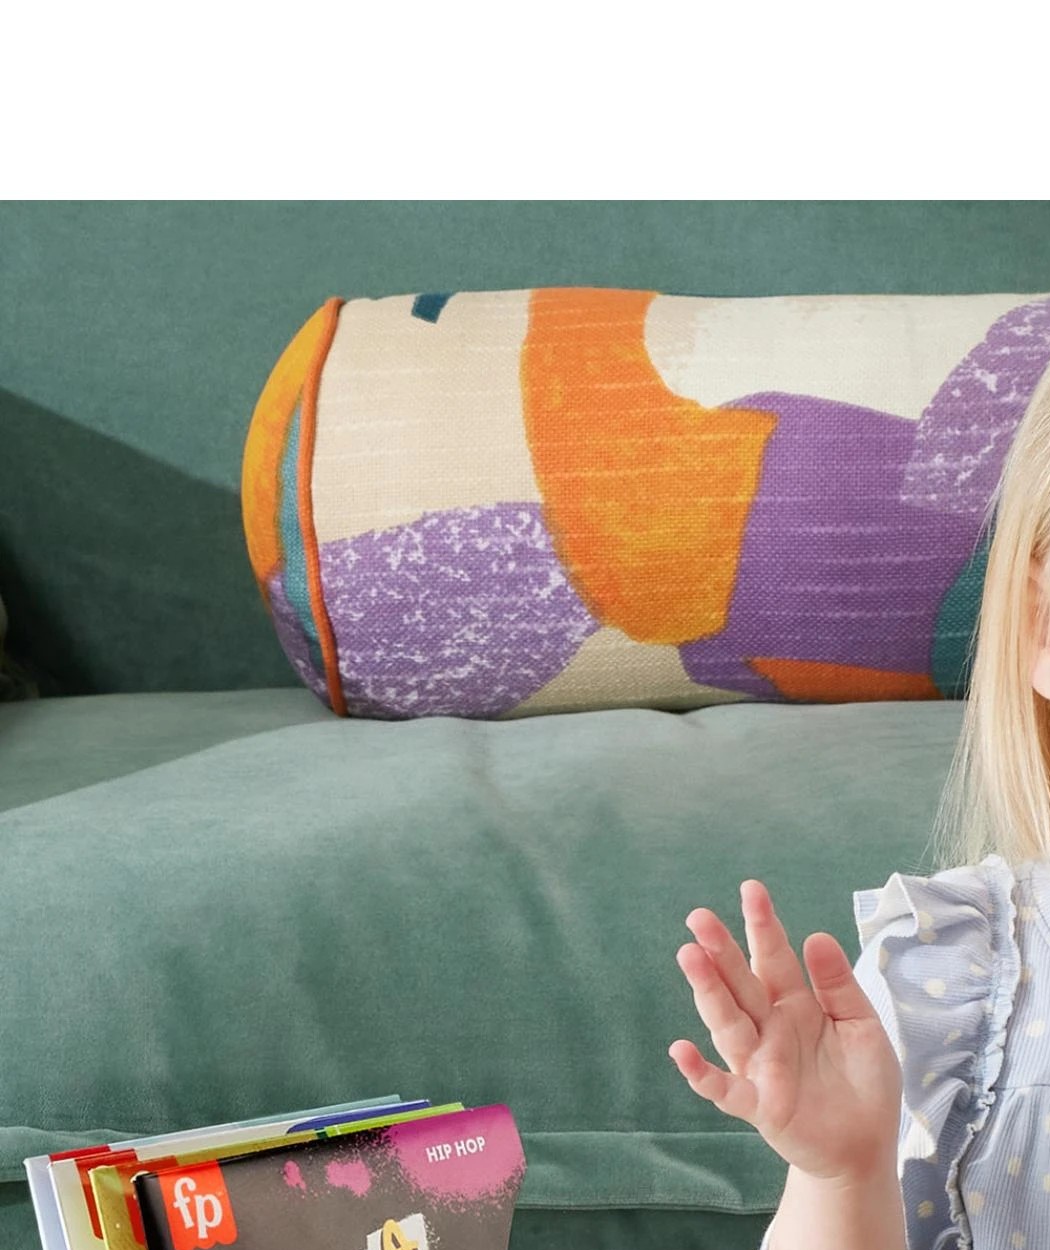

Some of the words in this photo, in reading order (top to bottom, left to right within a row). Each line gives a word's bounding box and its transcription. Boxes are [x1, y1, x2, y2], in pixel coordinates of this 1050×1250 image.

[425, 1143, 452, 1163] HIP
[454, 1136, 485, 1157] HOP
[173, 1176, 223, 1239] fp
